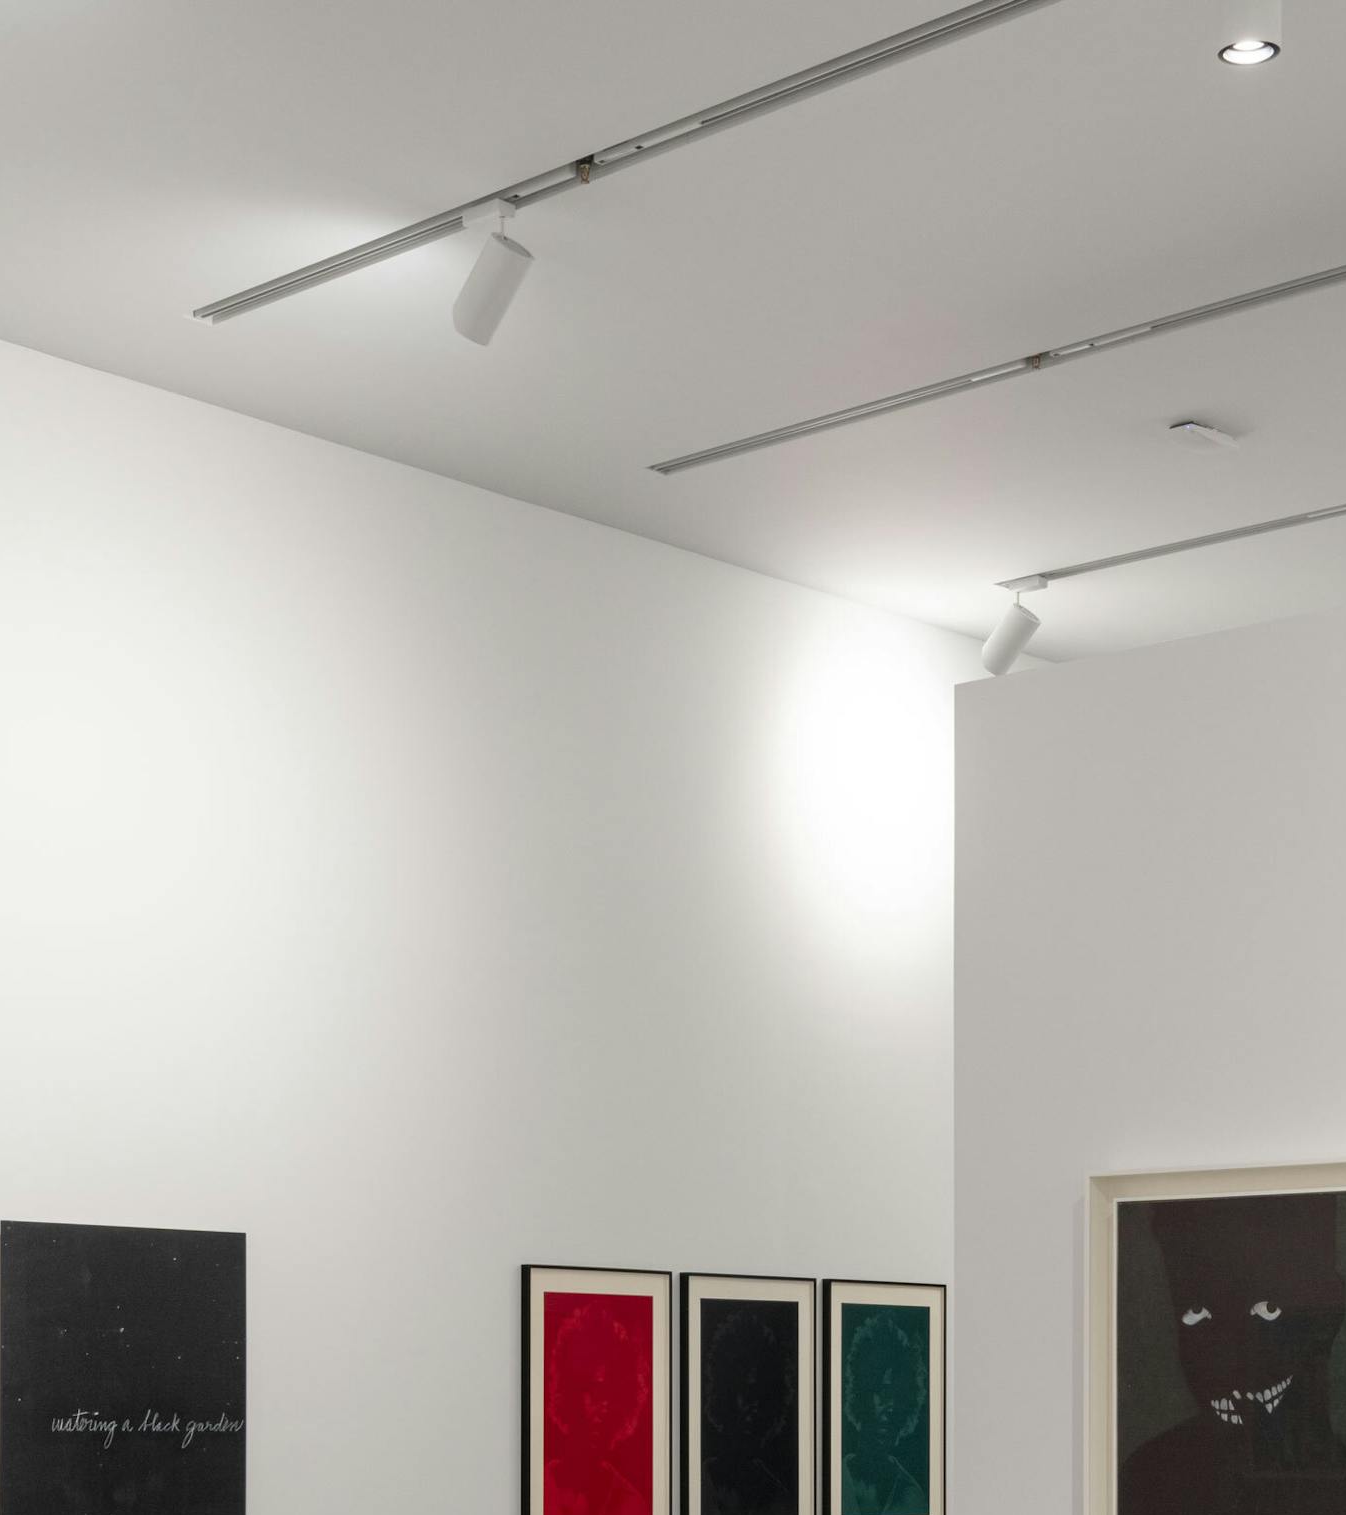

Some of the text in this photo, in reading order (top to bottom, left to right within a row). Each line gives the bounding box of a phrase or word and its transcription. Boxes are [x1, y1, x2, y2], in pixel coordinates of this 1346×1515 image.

[52, 1408, 244, 1449] watering a black garden
